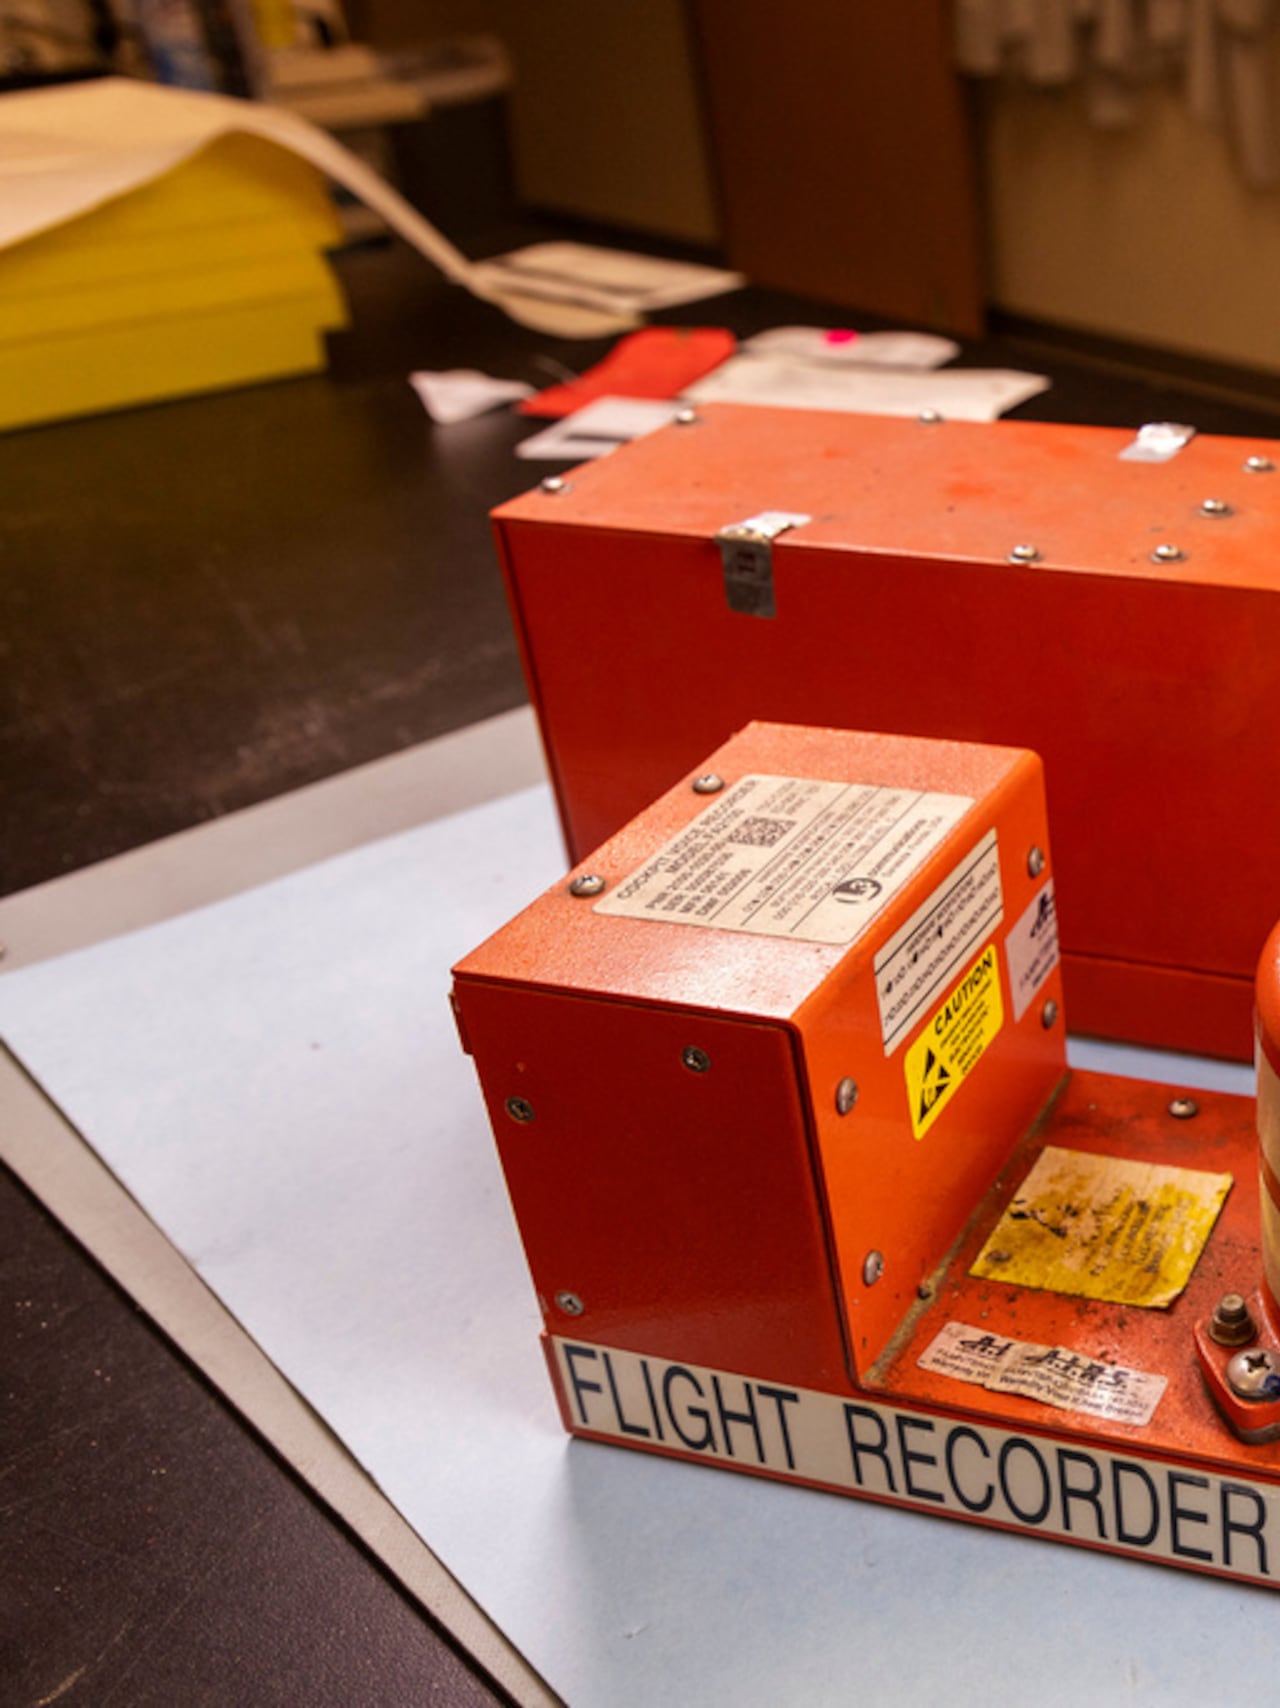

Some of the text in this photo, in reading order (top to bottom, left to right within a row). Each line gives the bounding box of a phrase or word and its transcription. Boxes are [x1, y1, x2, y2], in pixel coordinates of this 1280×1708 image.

[933, 949, 992, 1039] CAUTION
[561, 1344, 800, 1471] FLIGHT
[843, 1402, 1271, 1575] RECORDER
